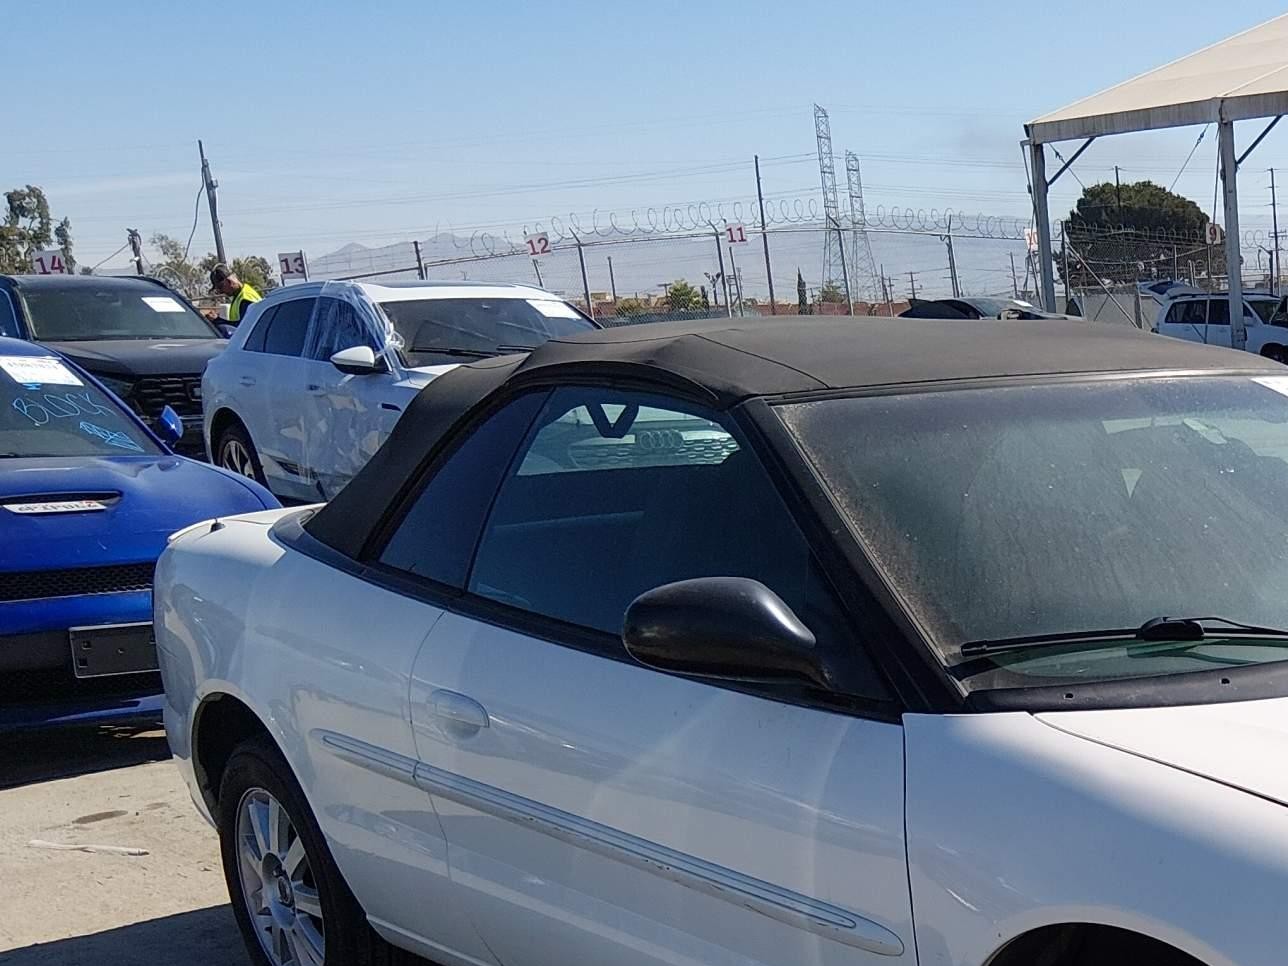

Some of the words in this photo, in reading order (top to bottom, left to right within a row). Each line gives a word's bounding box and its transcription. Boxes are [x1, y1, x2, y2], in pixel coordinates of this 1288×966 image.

[726, 227, 747, 243] 11
[1209, 227, 1217, 241] 9
[526, 237, 552, 255] 12
[35, 255, 65, 275] 14
[280, 257, 304, 274] 13
